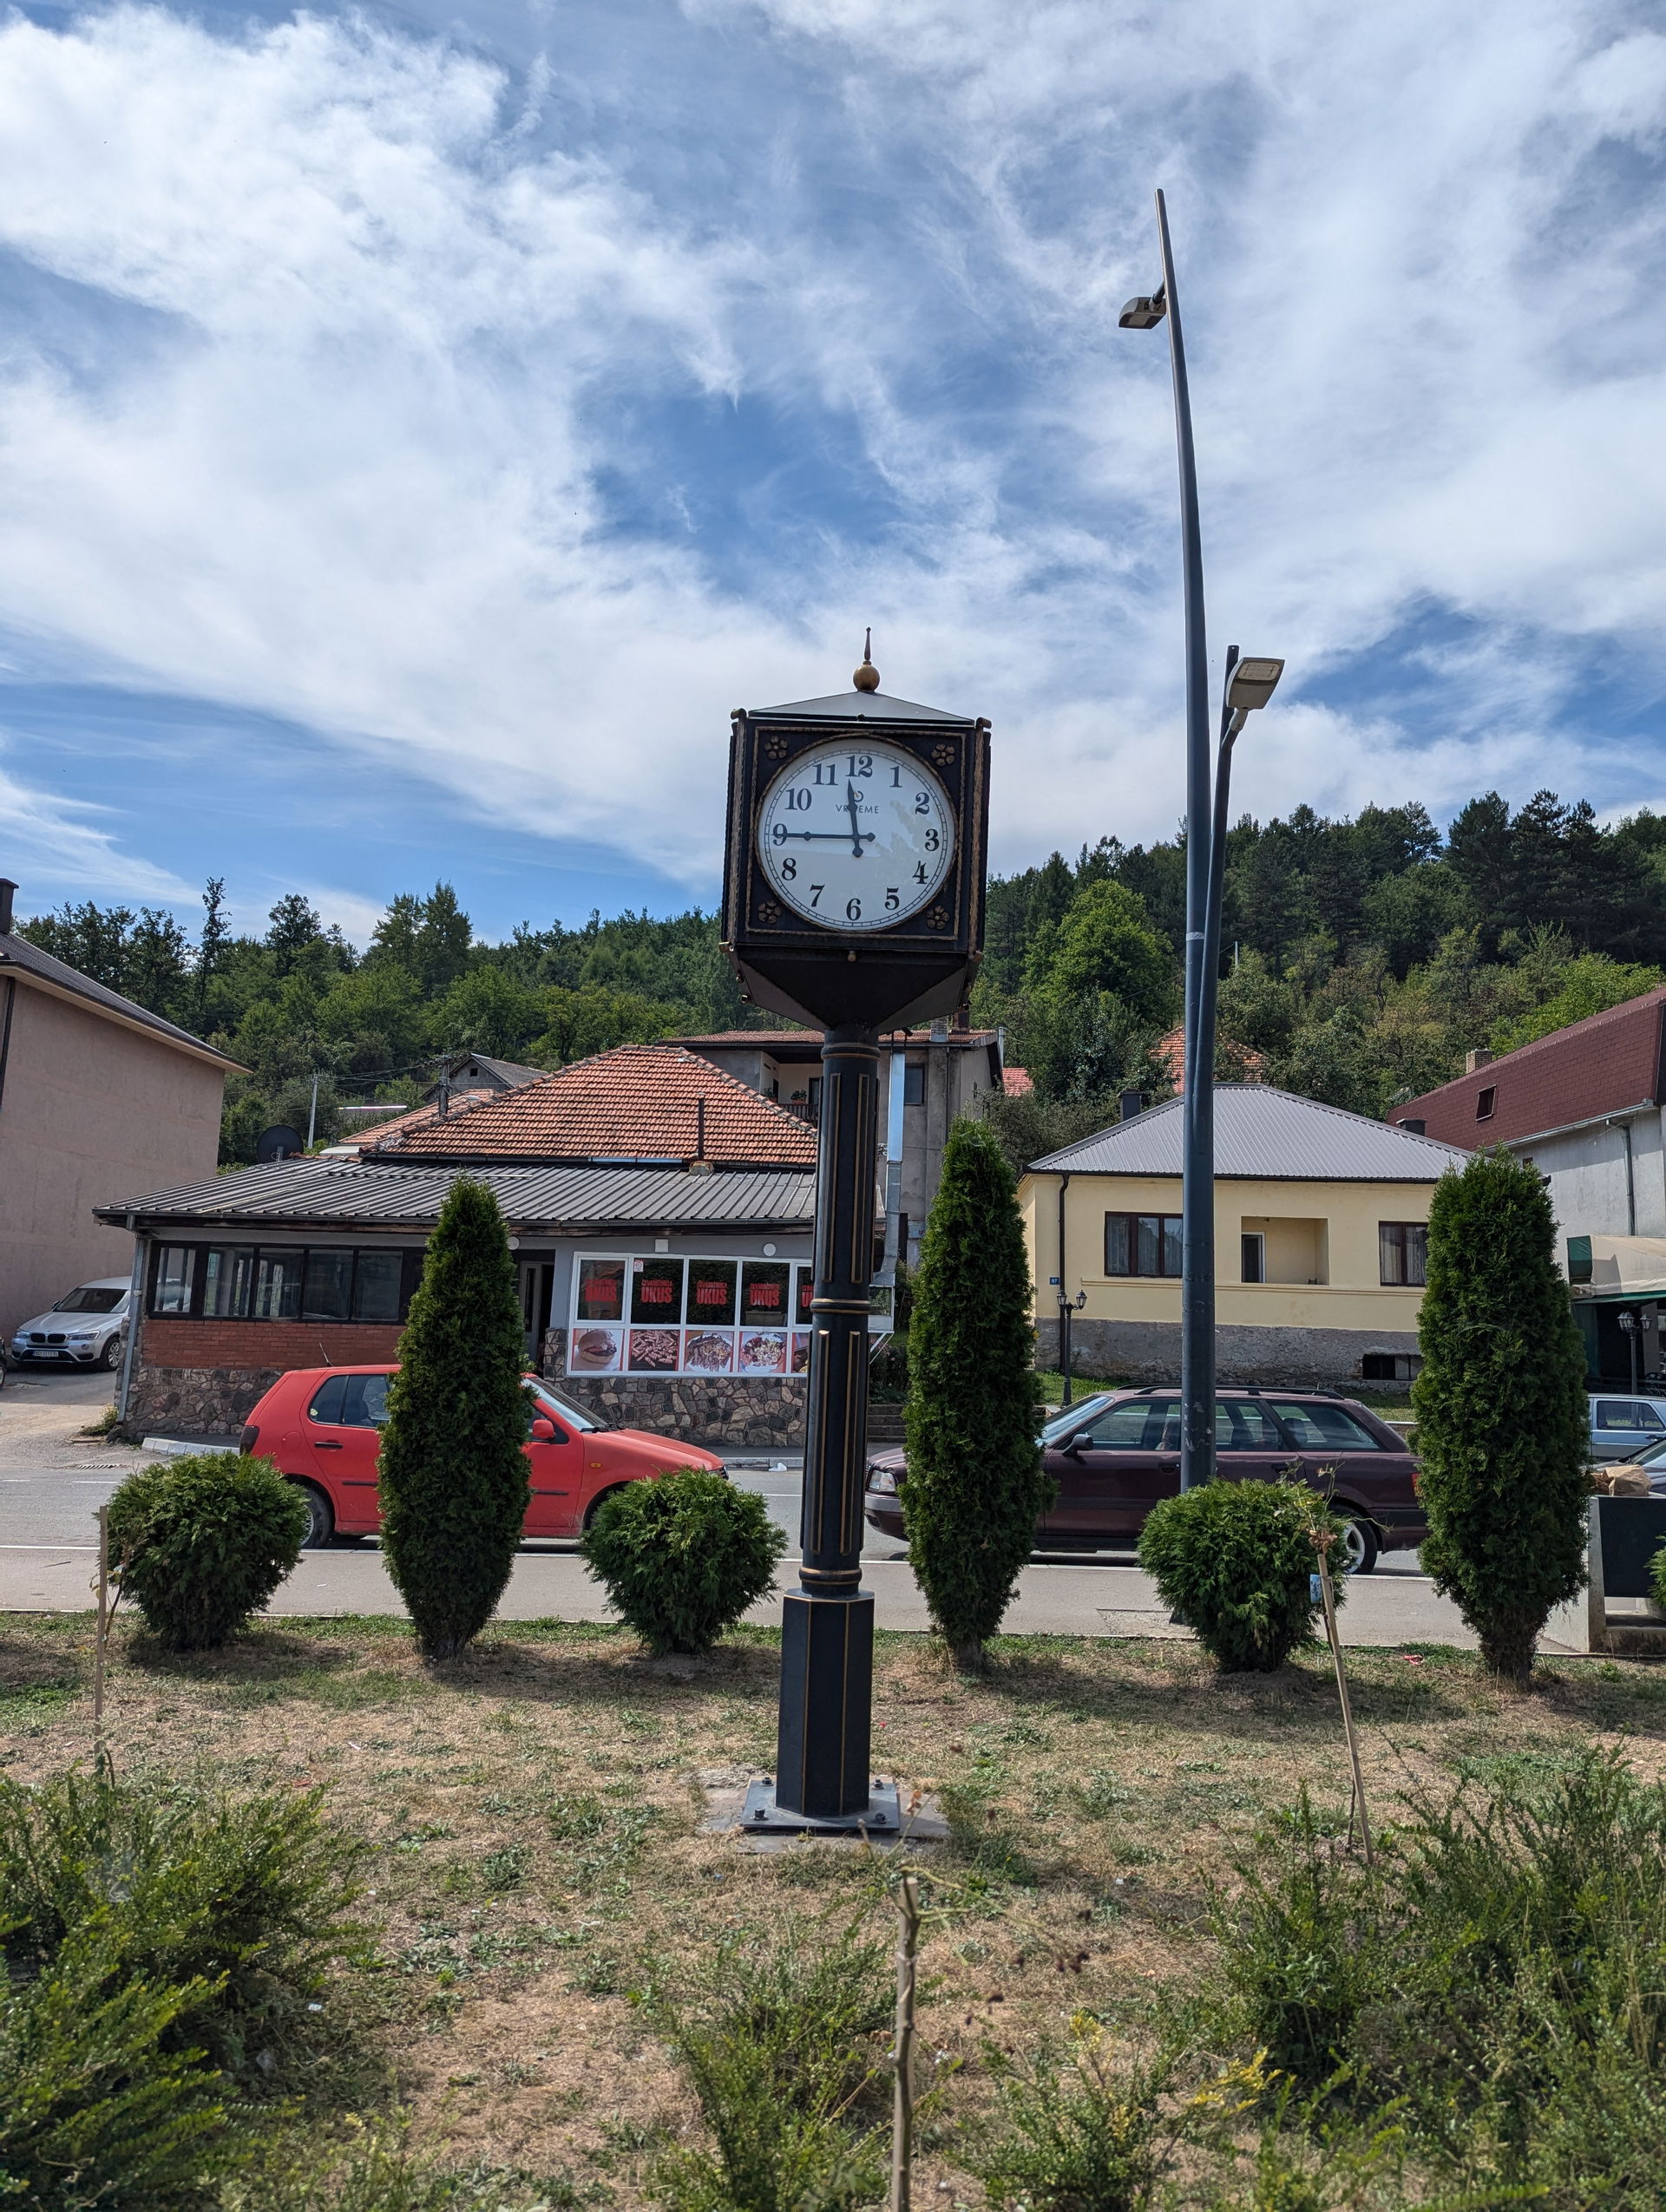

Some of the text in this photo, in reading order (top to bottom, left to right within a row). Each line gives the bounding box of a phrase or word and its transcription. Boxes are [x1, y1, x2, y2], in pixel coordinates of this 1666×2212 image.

[812, 763, 838, 786] 11
[845, 755, 873, 778] 12
[889, 765, 902, 788] 1
[784, 788, 812, 811] 10
[915, 792, 930, 815] 2
[772, 823, 788, 846] 9
[925, 828, 940, 852] 3
[781, 857, 797, 880] 8
[912, 861, 928, 885] 4
[810, 884, 825, 907] 7
[884, 887, 900, 911] 5
[846, 898, 862, 921] 6
[641, 1286, 672, 1303] UKUS
[697, 1288, 727, 1306] UKUS
[750, 1290, 779, 1306] UKUS
